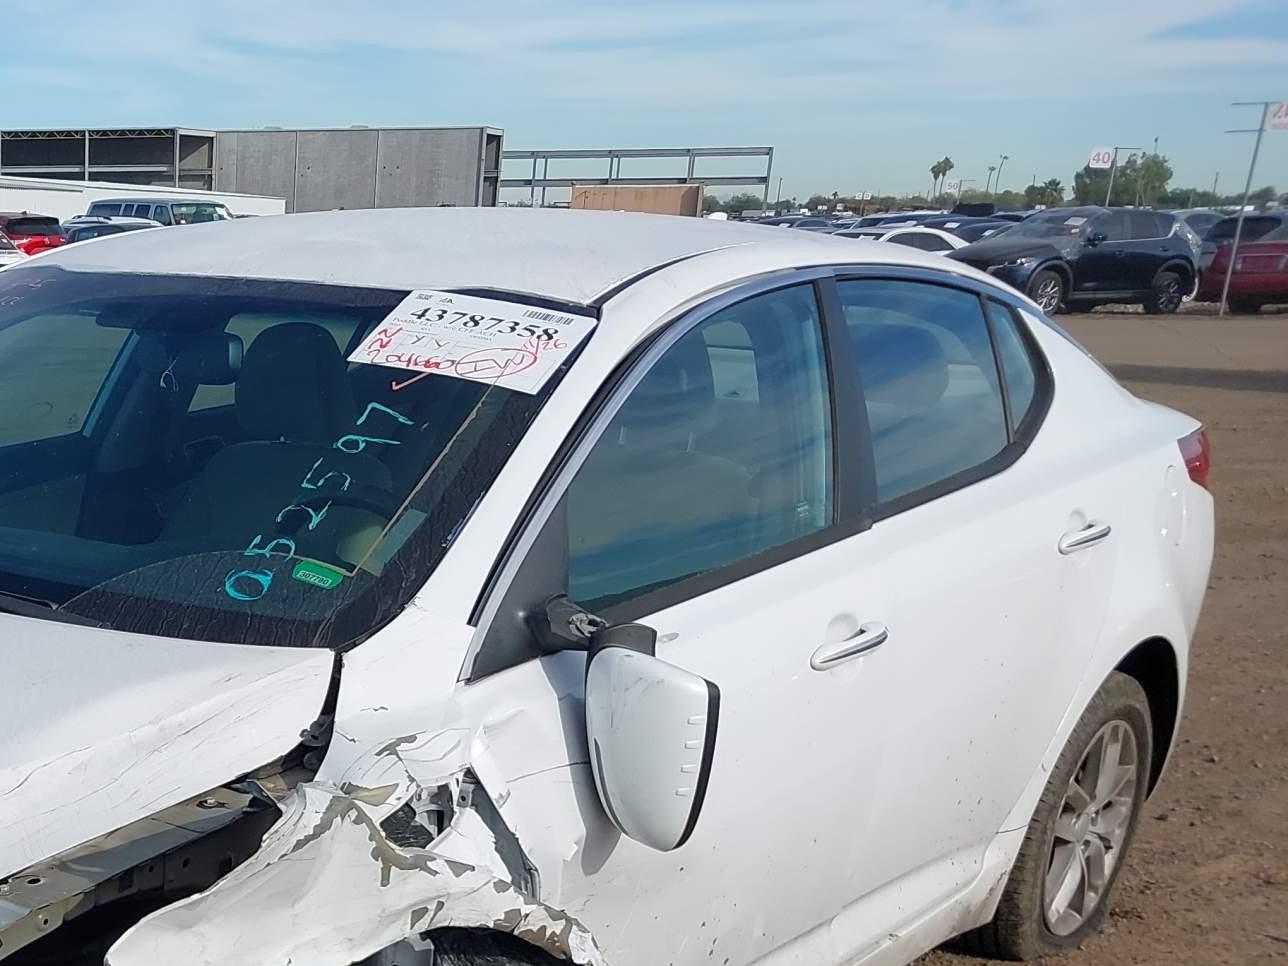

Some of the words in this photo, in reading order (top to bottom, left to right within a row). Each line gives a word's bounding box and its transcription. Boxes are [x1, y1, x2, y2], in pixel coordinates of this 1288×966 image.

[1092, 151, 1111, 164] 40
[411, 307, 559, 341] 43787358
[224, 402, 415, 601] 0525597
